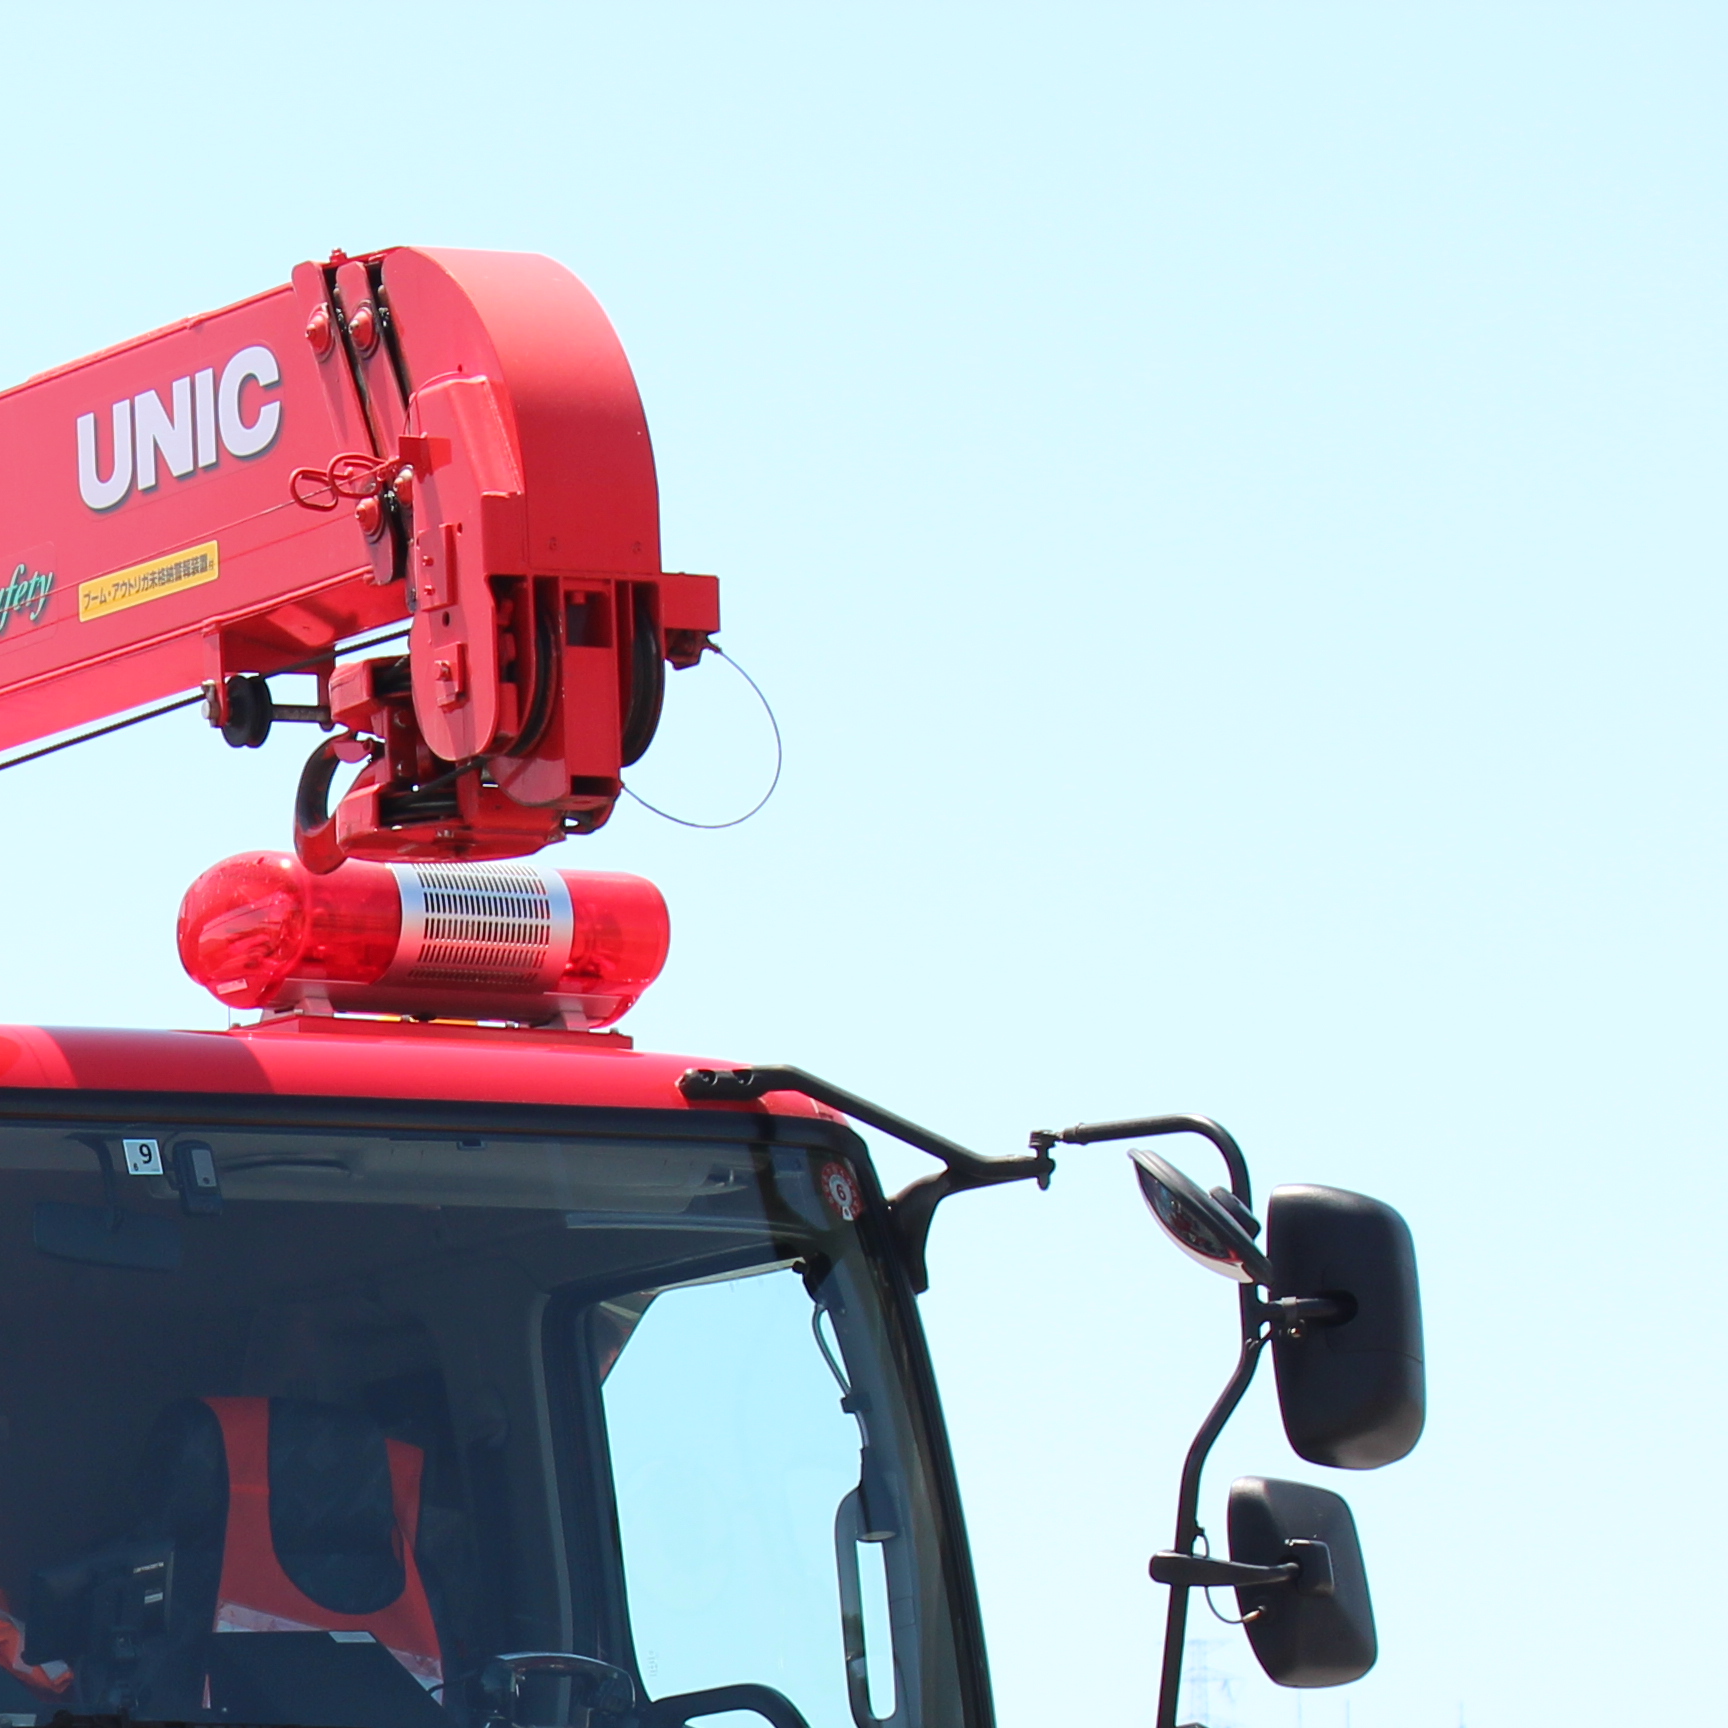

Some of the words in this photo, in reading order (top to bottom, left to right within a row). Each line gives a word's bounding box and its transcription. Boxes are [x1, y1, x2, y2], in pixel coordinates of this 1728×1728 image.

[76, 344, 282, 514] UNIC
[138, 1143, 153, 1164] 9
[835, 1183, 847, 1201] 6
